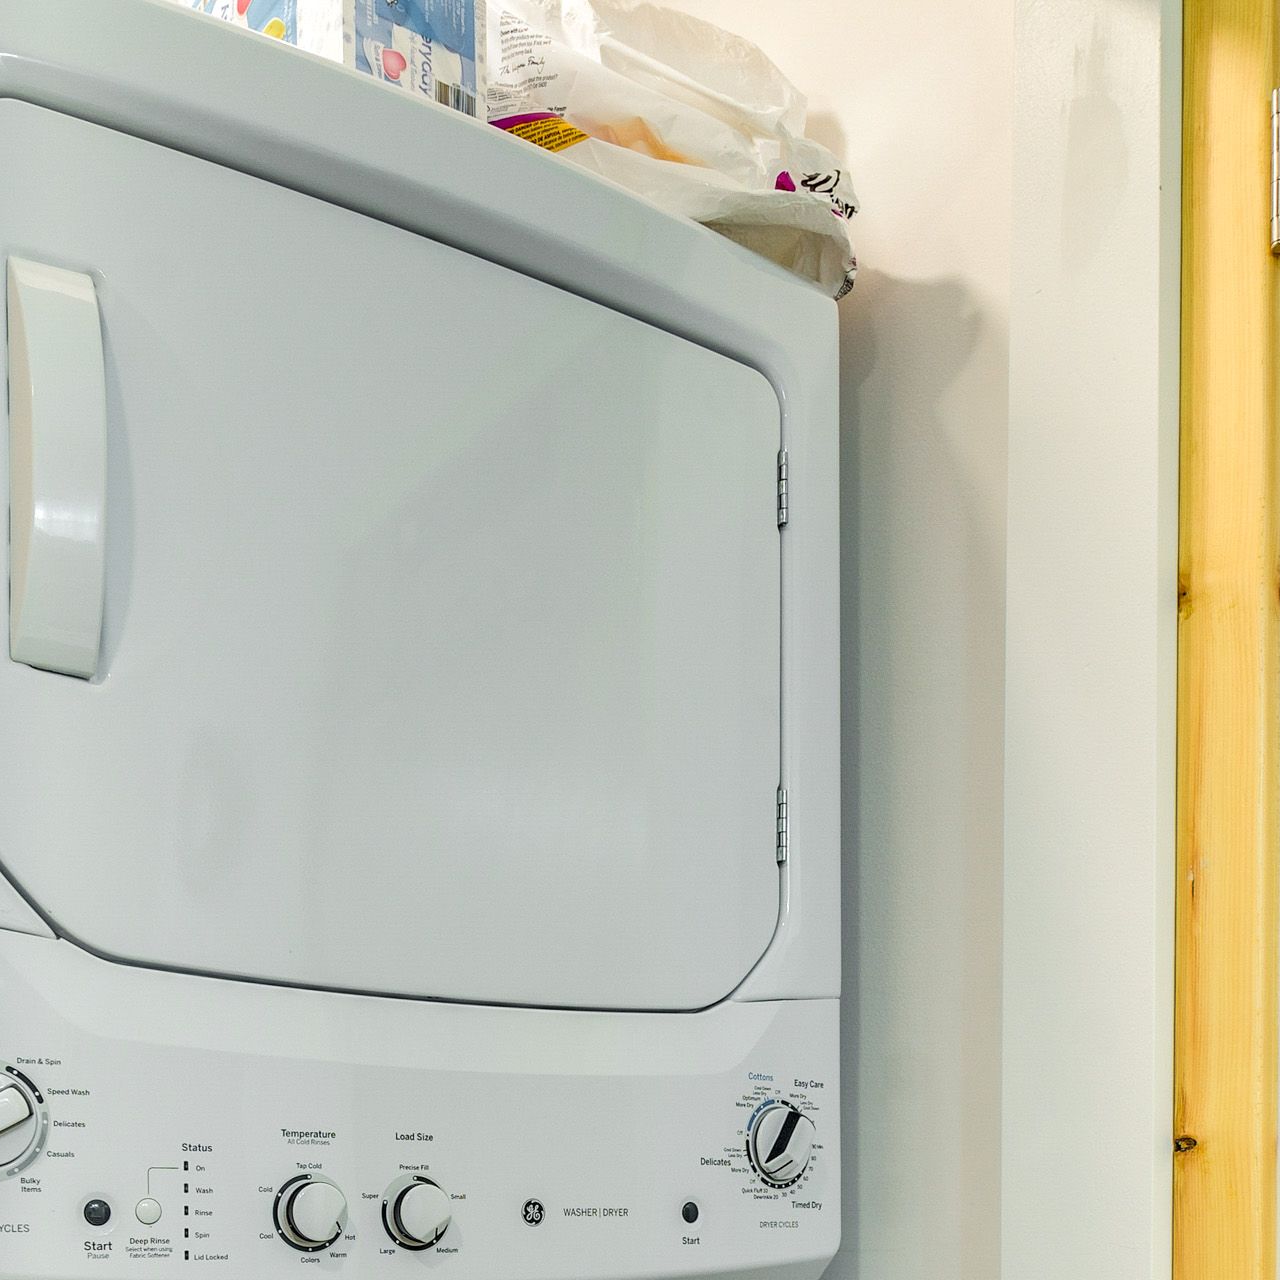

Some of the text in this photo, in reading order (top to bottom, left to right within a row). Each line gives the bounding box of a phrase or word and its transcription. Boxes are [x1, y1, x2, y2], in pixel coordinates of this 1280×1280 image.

[749, 1072, 773, 1081] Cottons
[794, 1079, 824, 1089] Easy Care
[47, 1088, 69, 1096] Speed
[53, 1120, 85, 1128] Delicates
[281, 1129, 336, 1139] Temperature
[395, 1132, 433, 1141] Load Size
[182, 1143, 213, 1152] Status
[700, 1158, 731, 1166] Delicates
[20, 1177, 40, 1185] Bulky
[812, 1202, 822, 1210] Dry
[563, 1208, 629, 1216] WASHER DRYER
[682, 1237, 700, 1245] Start
[84, 1242, 112, 1250] Start
